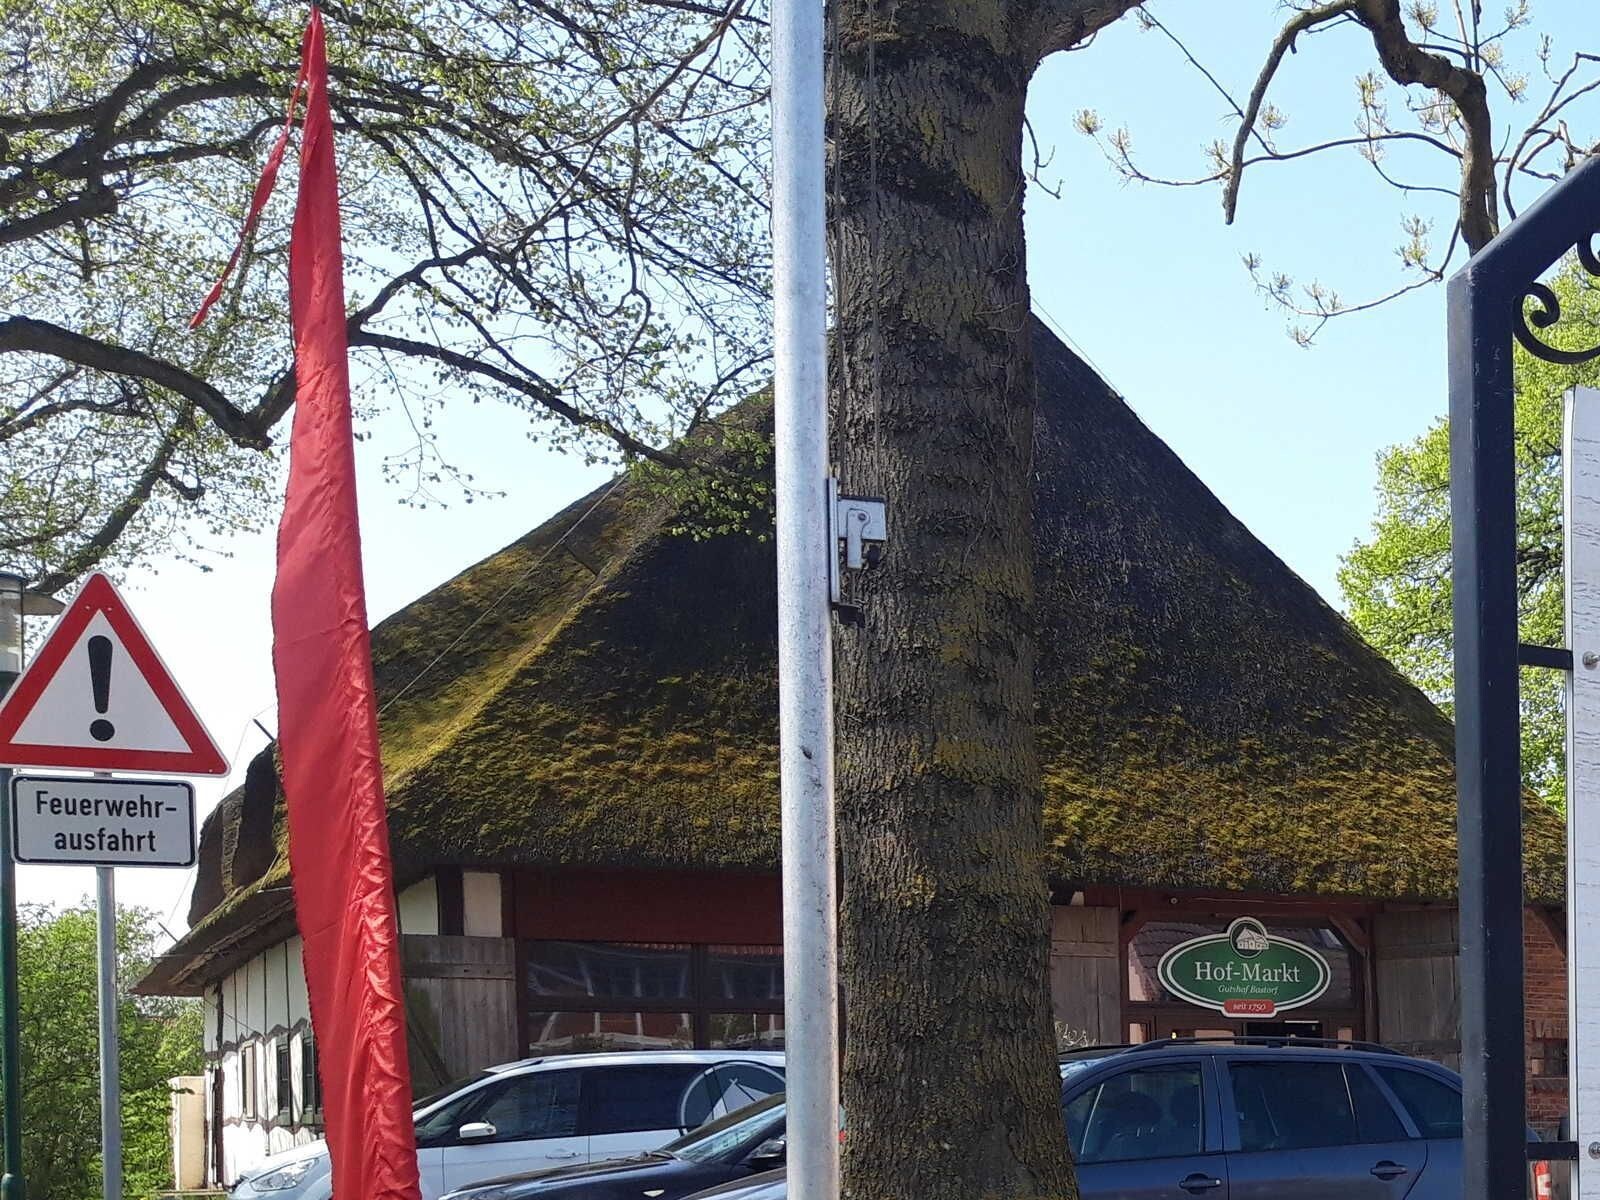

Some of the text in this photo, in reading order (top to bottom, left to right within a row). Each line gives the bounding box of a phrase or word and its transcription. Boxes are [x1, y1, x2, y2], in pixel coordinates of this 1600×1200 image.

[36, 790, 177, 818] Feuerwehr-
[54, 828, 157, 853] ausfahrt
[1194, 961, 1301, 983] Hof-Markt
